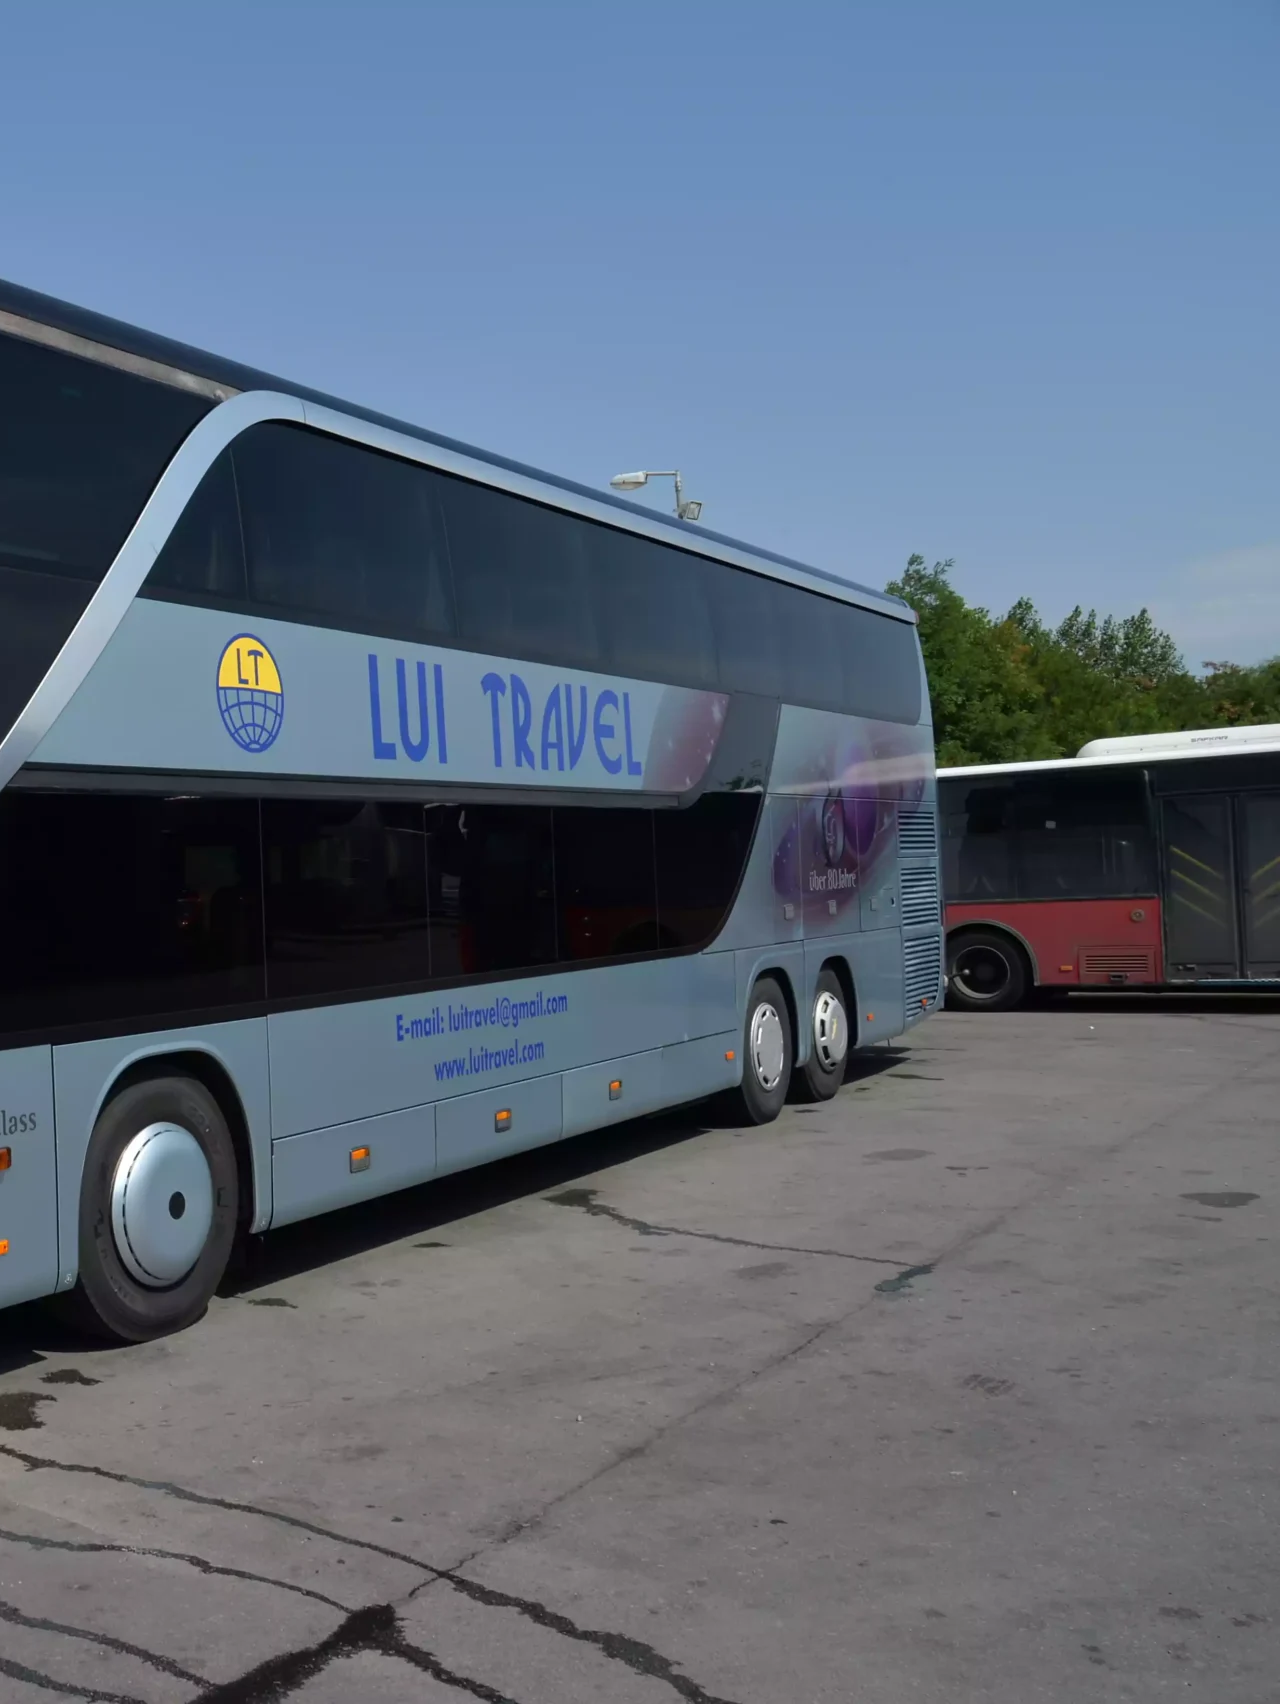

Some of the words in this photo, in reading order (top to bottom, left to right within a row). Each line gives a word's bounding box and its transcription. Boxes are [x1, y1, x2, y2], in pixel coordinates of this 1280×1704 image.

[236, 647, 264, 686] LT
[368, 653, 448, 764] LUI
[480, 672, 642, 776] TRAVEL
[809, 870, 827, 891] über
[827, 868, 838, 890] 80
[396, 1007, 444, 1041] E-mail:
[448, 991, 568, 1032] luitravel@gmail.com
[434, 1039, 545, 1081] www.luitravel.com
